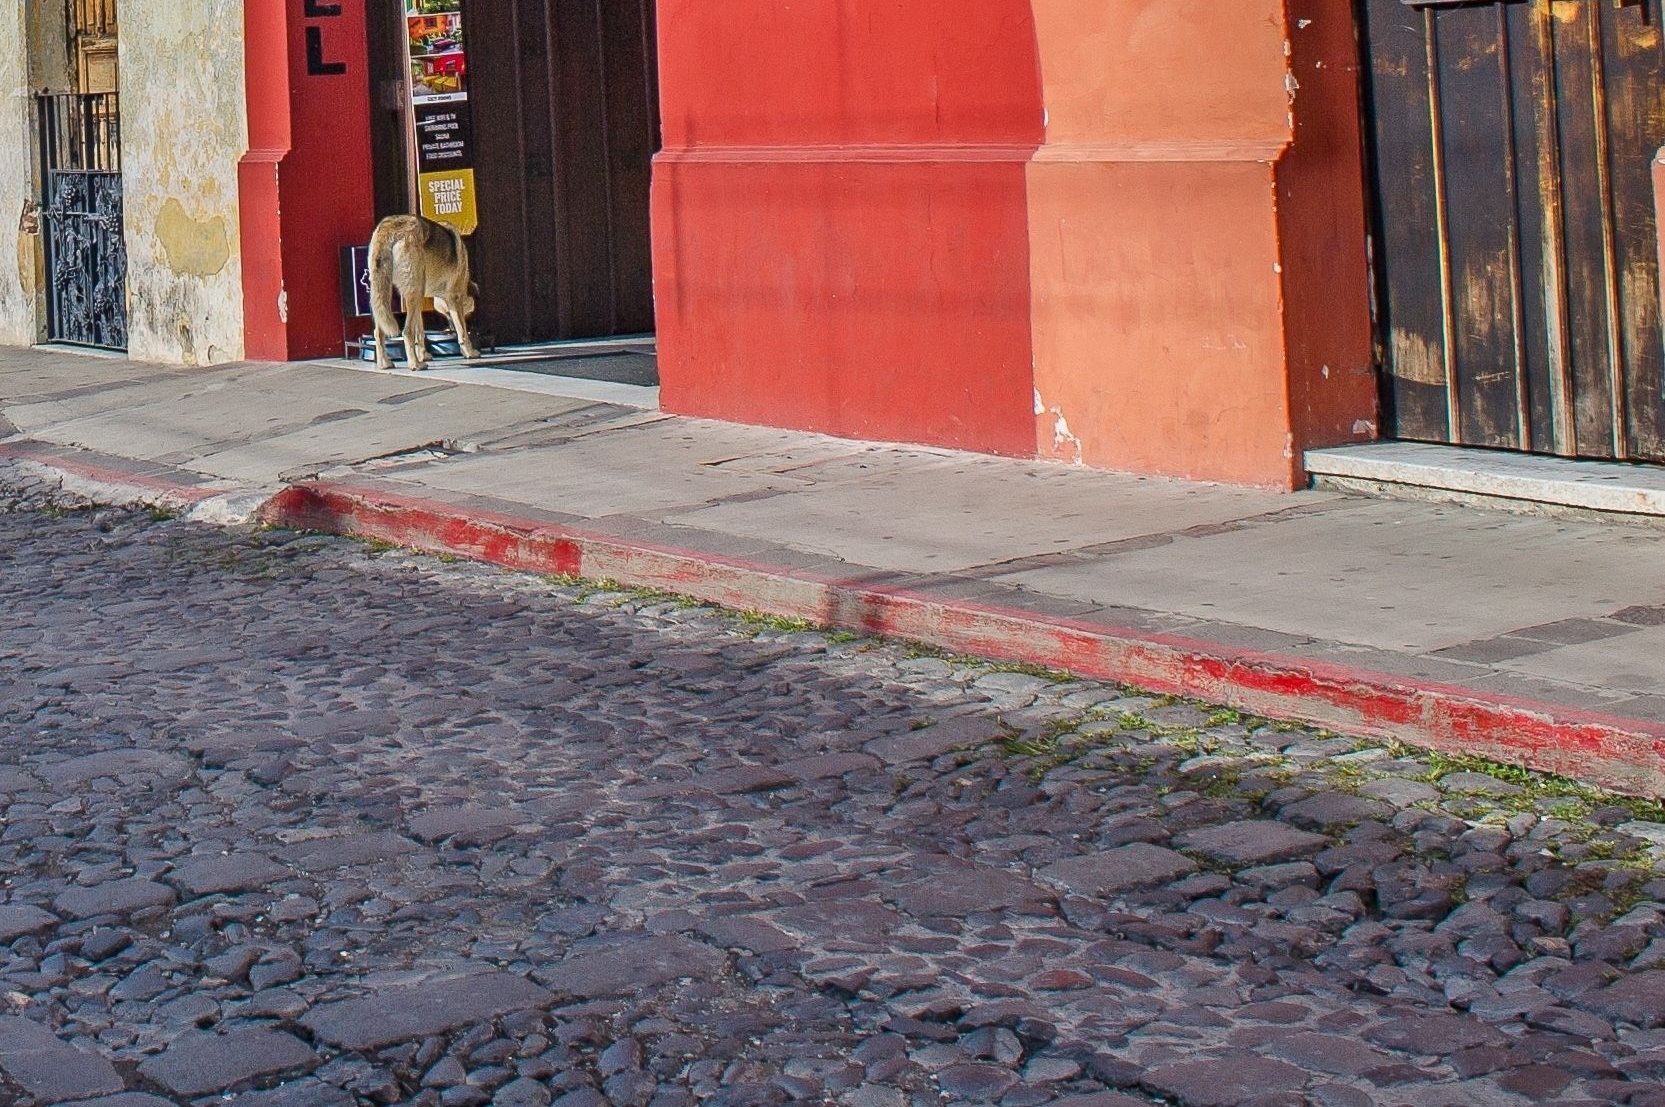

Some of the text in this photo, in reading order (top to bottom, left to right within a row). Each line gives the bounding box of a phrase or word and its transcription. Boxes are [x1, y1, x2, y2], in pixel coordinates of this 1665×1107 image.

[429, 179, 465, 192] SPECIAL
[434, 190, 462, 203] PRICE
[433, 201, 463, 215] TODAY
